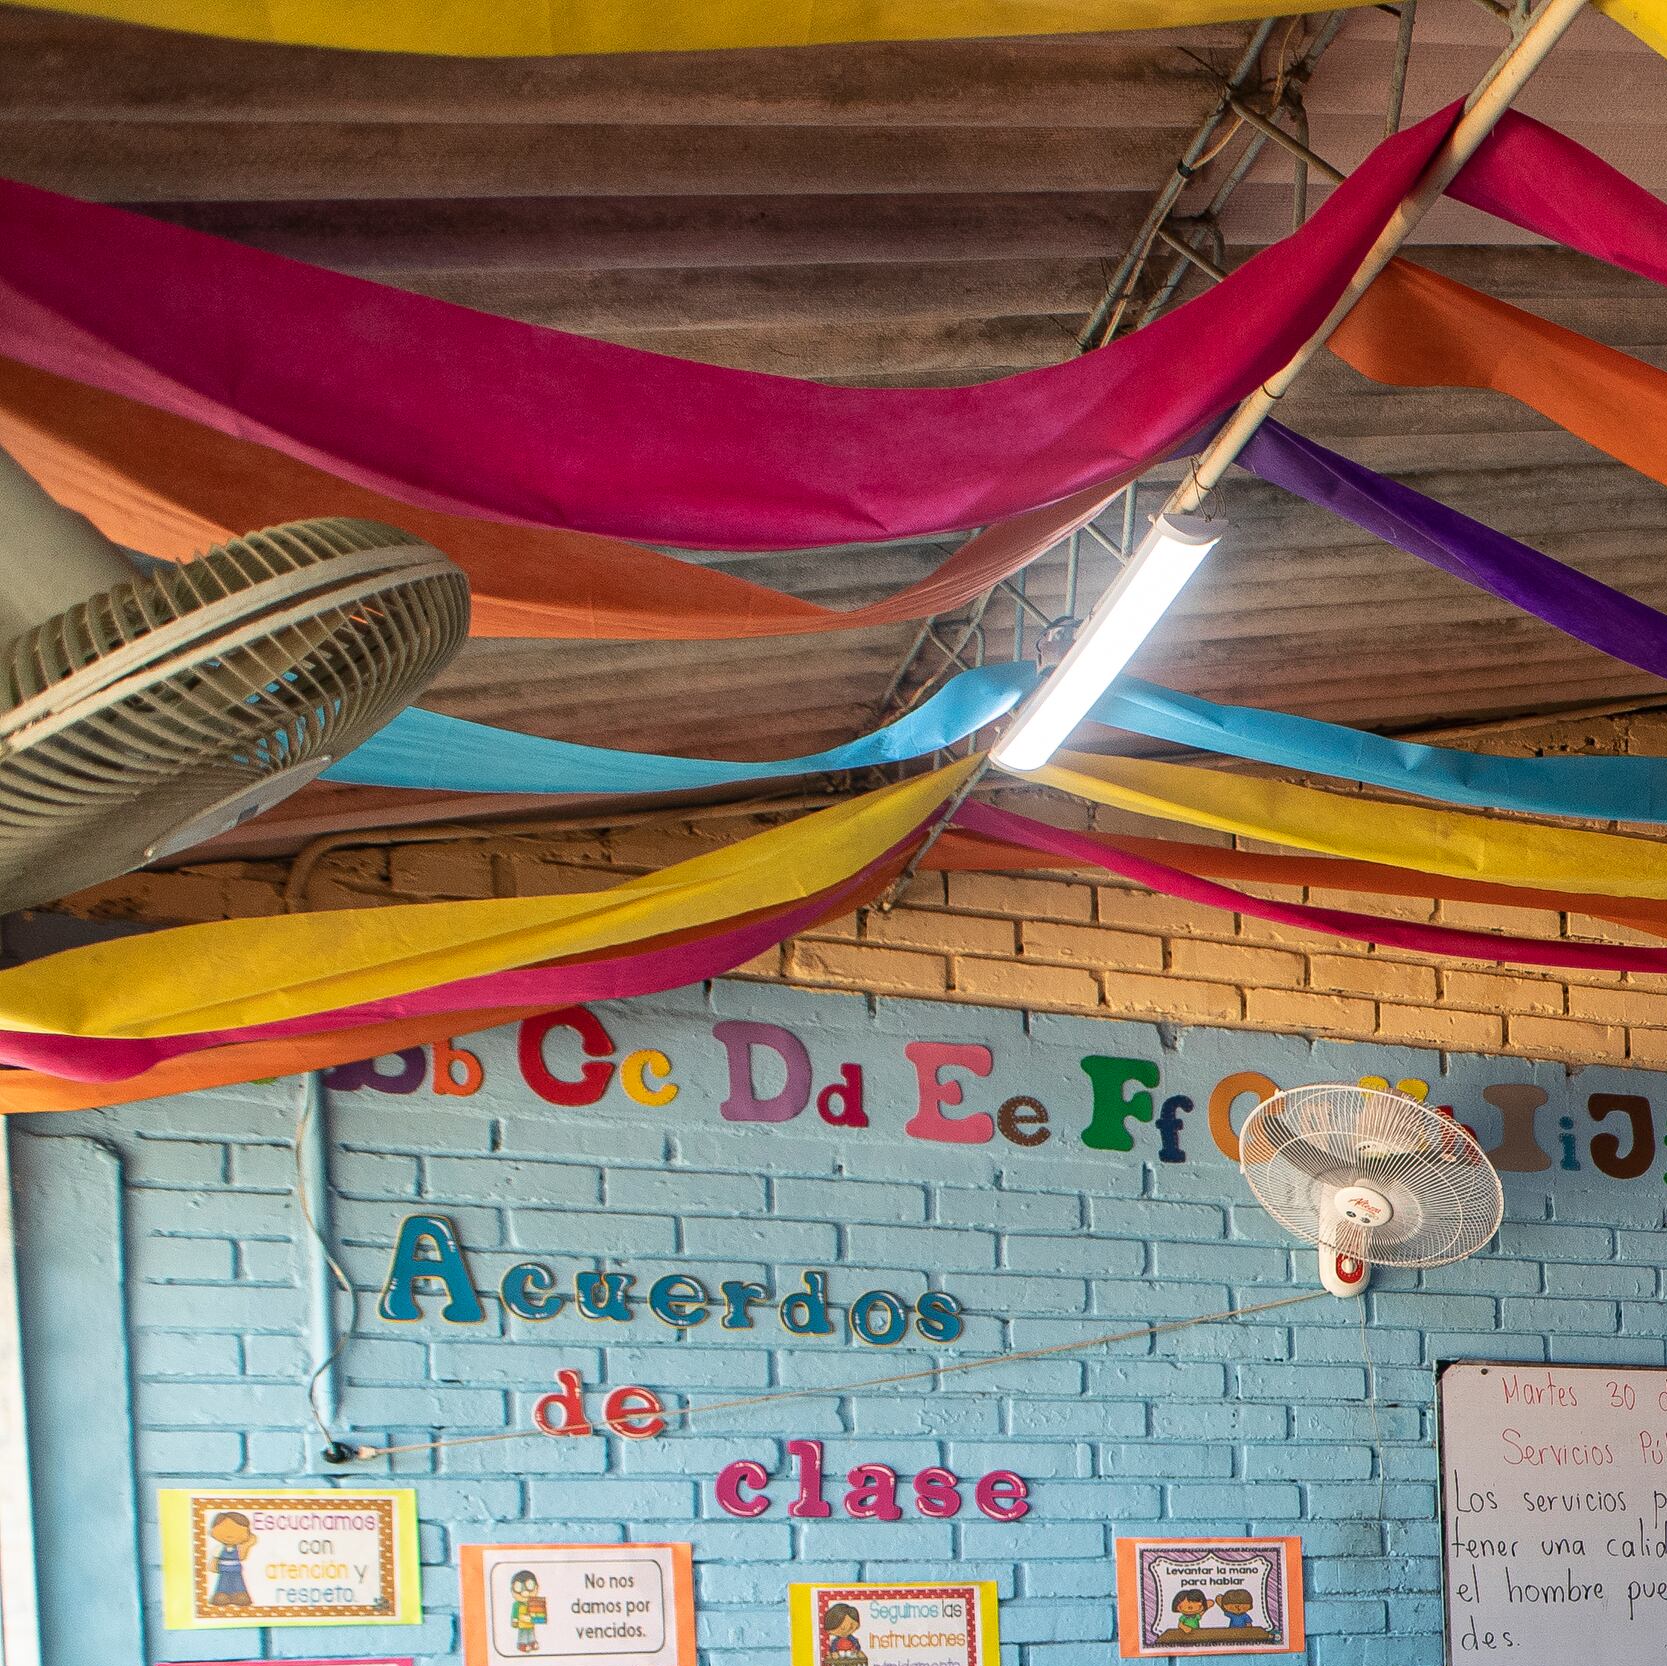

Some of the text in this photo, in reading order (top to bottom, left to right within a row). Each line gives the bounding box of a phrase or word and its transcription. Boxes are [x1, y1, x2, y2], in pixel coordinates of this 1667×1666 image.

[377, 1213, 964, 1347] Acuerdos
[531, 1368, 668, 1439] de
[1501, 1372, 1579, 1410] Martes
[1606, 1380, 1636, 1411] 30
[1502, 1428, 1614, 1467] Servicios
[714, 1440, 1036, 1522] clase
[1454, 1469, 1499, 1513] Los
[1523, 1487, 1627, 1513] servicios
[253, 1511, 377, 1531] Escuchamos
[1451, 1517, 1520, 1558] tener
[1541, 1535, 1586, 1556] una
[298, 1537, 334, 1556] con
[584, 1573, 635, 1589] No nos
[1166, 1566, 1214, 1576] Levantar
[1209, 1576, 1245, 1586] hablar
[1456, 1566, 1480, 1603] el
[1505, 1566, 1605, 1603] hombre
[571, 1599, 650, 1617] damos por
[869, 1600, 962, 1624] Seguimos las
[576, 1624, 647, 1639] vencidos.
[1461, 1615, 1520, 1651] des.
